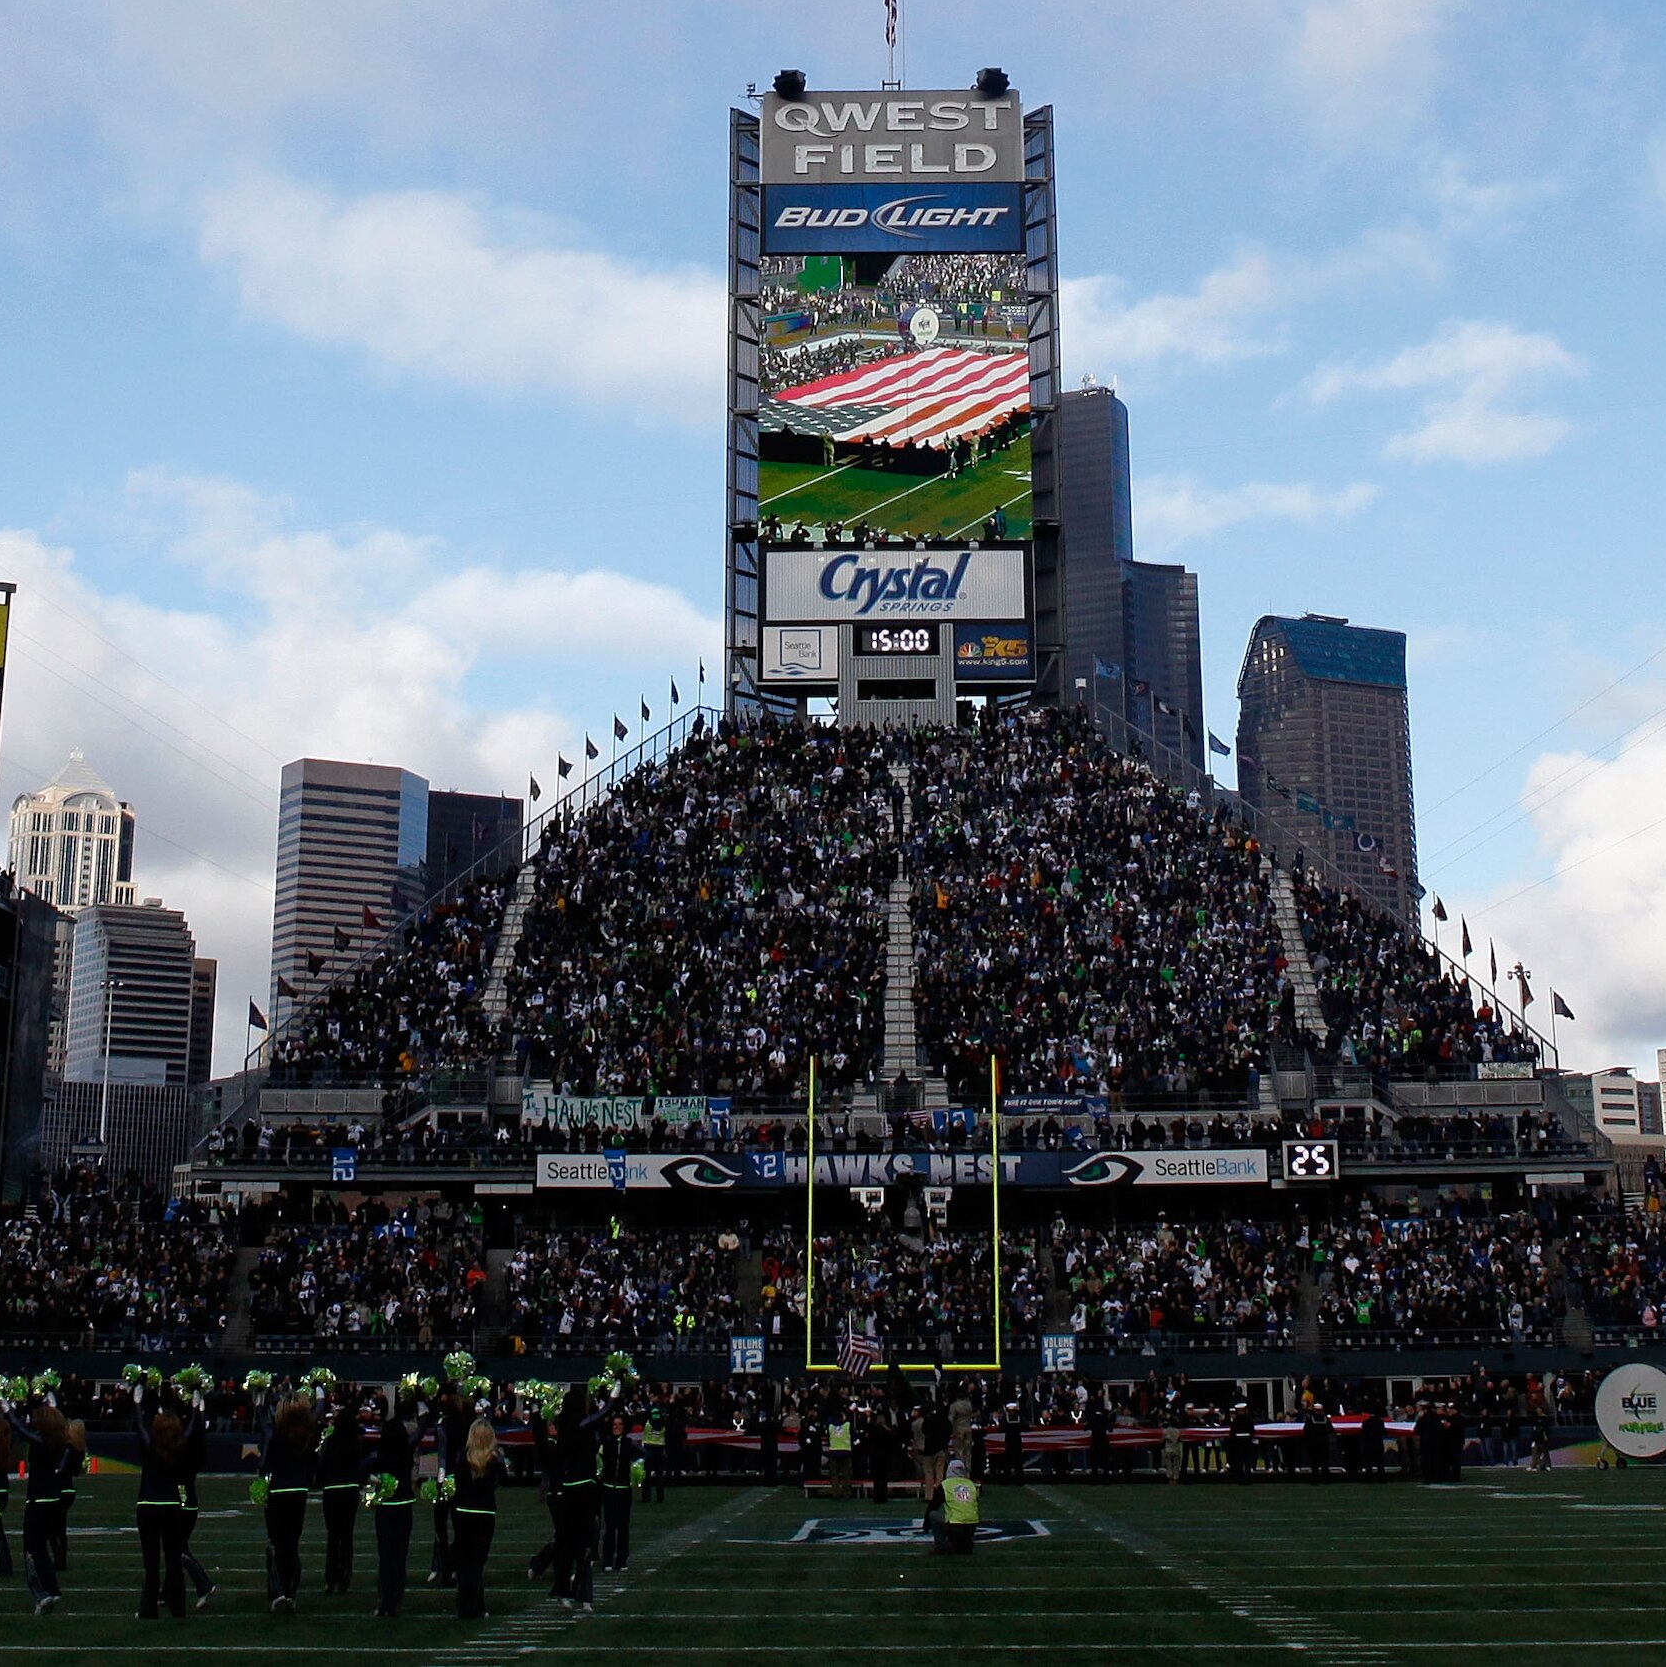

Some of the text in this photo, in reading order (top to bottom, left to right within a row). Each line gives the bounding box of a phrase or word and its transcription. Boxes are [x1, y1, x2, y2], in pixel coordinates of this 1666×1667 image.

[775, 101, 1011, 138] QWEST
[794, 143, 997, 174] FIELD
[774, 206, 1009, 227] BUD LIGHT
[819, 552, 973, 615] Crystal
[879, 601, 955, 613] SPRINGS
[784, 642, 811, 650] Seattle
[871, 629, 930, 652] 15:00
[798, 650, 817, 658] Bank
[957, 658, 1028, 666] www.king5.com
[603, 1097, 642, 1128] NEST
[332, 1156, 355, 1182] 12
[548, 1162, 648, 1180] Seattleank
[786, 1154, 1022, 1184] HAWKS NEST
[1155, 1158, 1257, 1176] SeattleBank
[1292, 1145, 1330, 1175] 25
[732, 1339, 763, 1350] VOLUME
[1043, 1337, 1074, 1348] VOLUME
[732, 1350, 764, 1374] 12
[1044, 1348, 1076, 1372] 12
